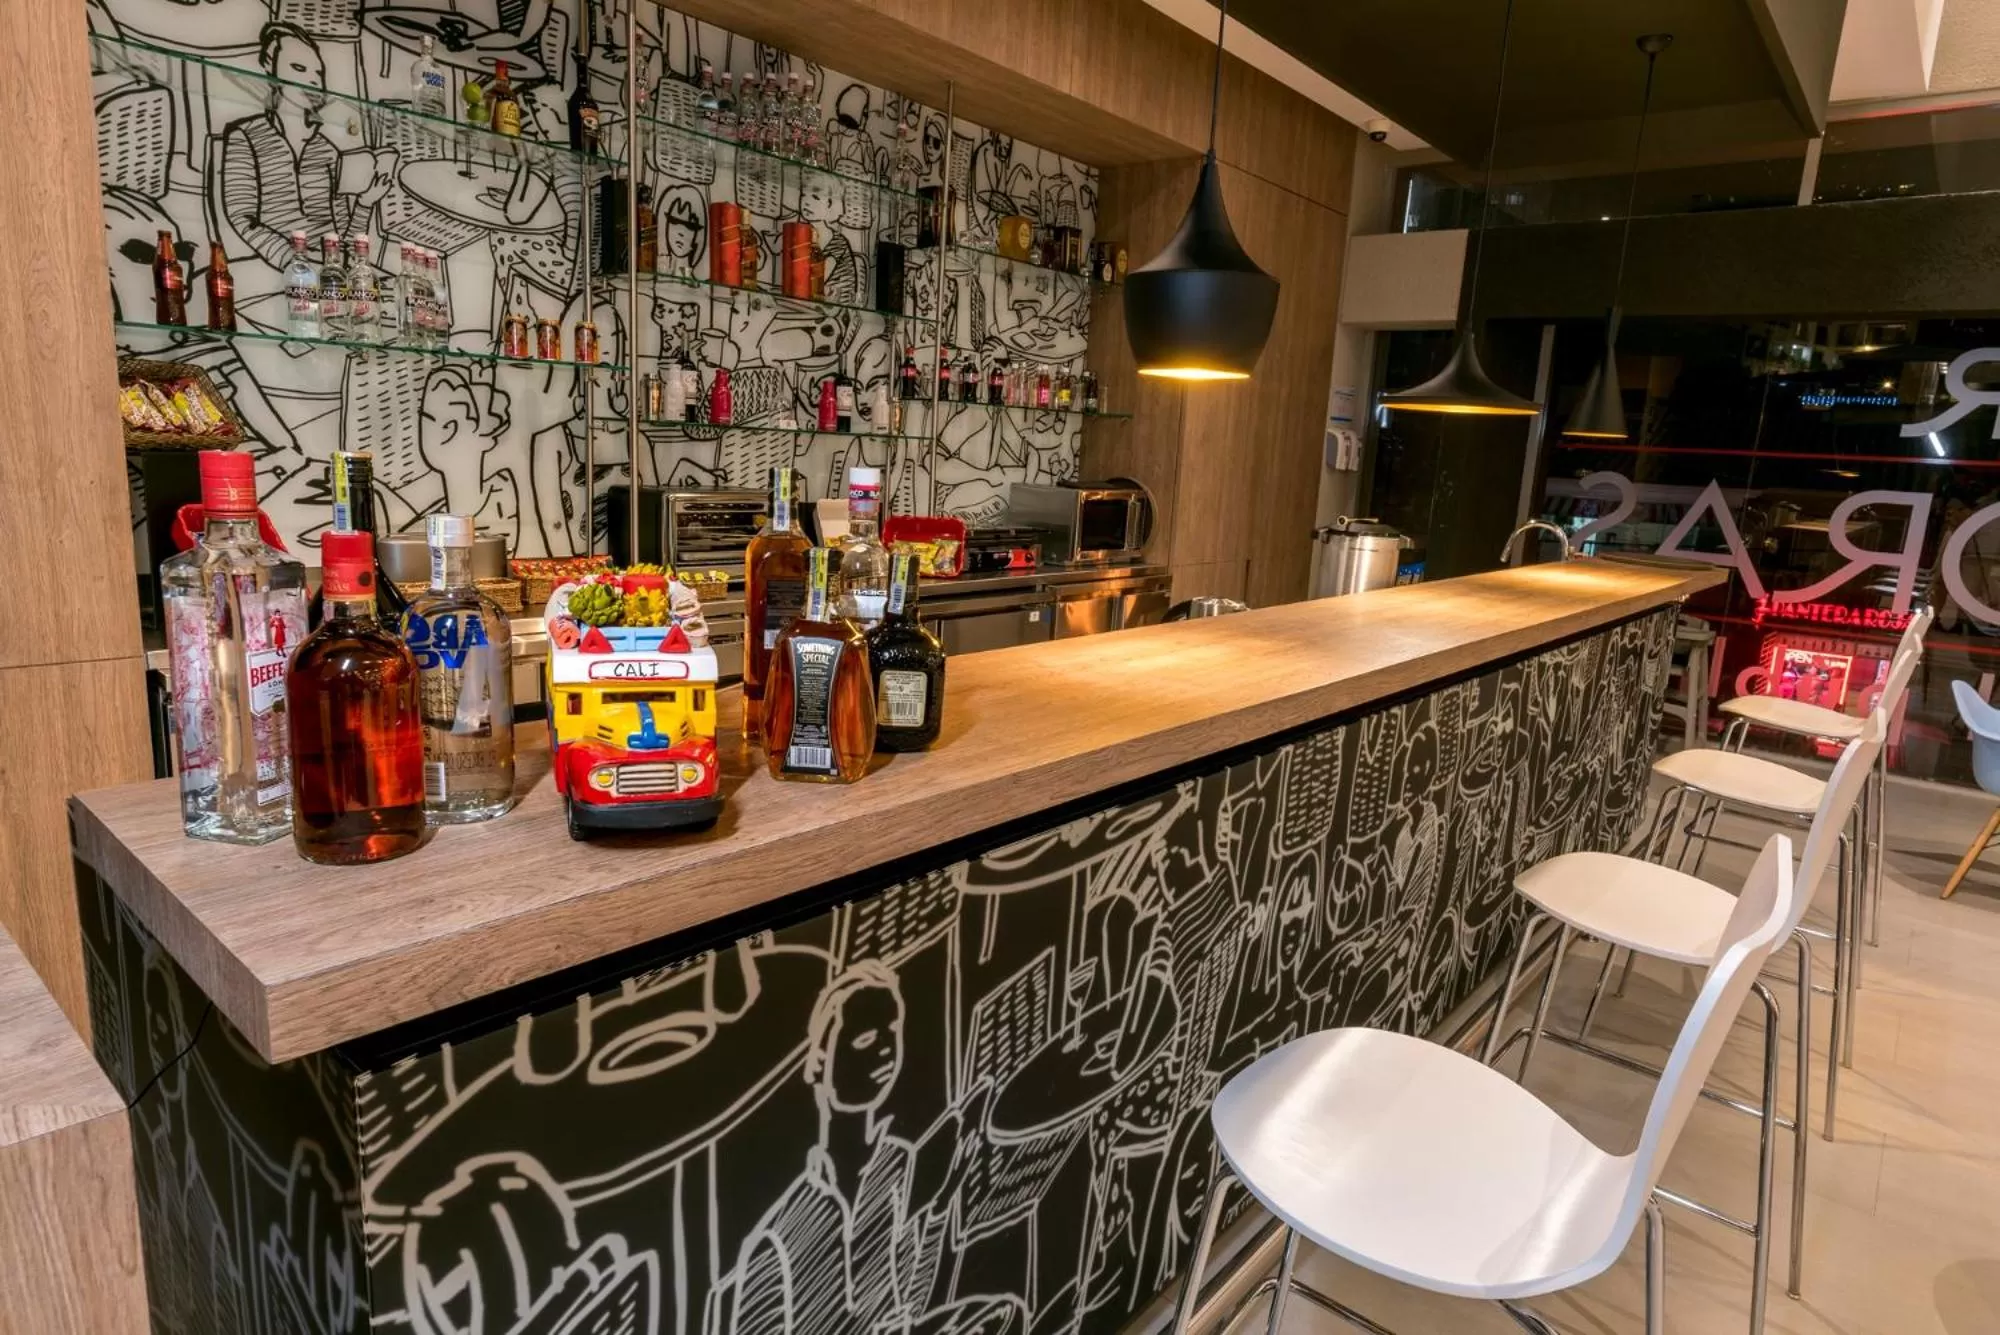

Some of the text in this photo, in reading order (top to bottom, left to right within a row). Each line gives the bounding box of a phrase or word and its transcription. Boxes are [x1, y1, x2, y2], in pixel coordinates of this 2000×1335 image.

[796, 643, 836, 656] SOMETHING
[802, 652, 831, 665] SPECIAL
[613, 662, 660, 678] CALI
